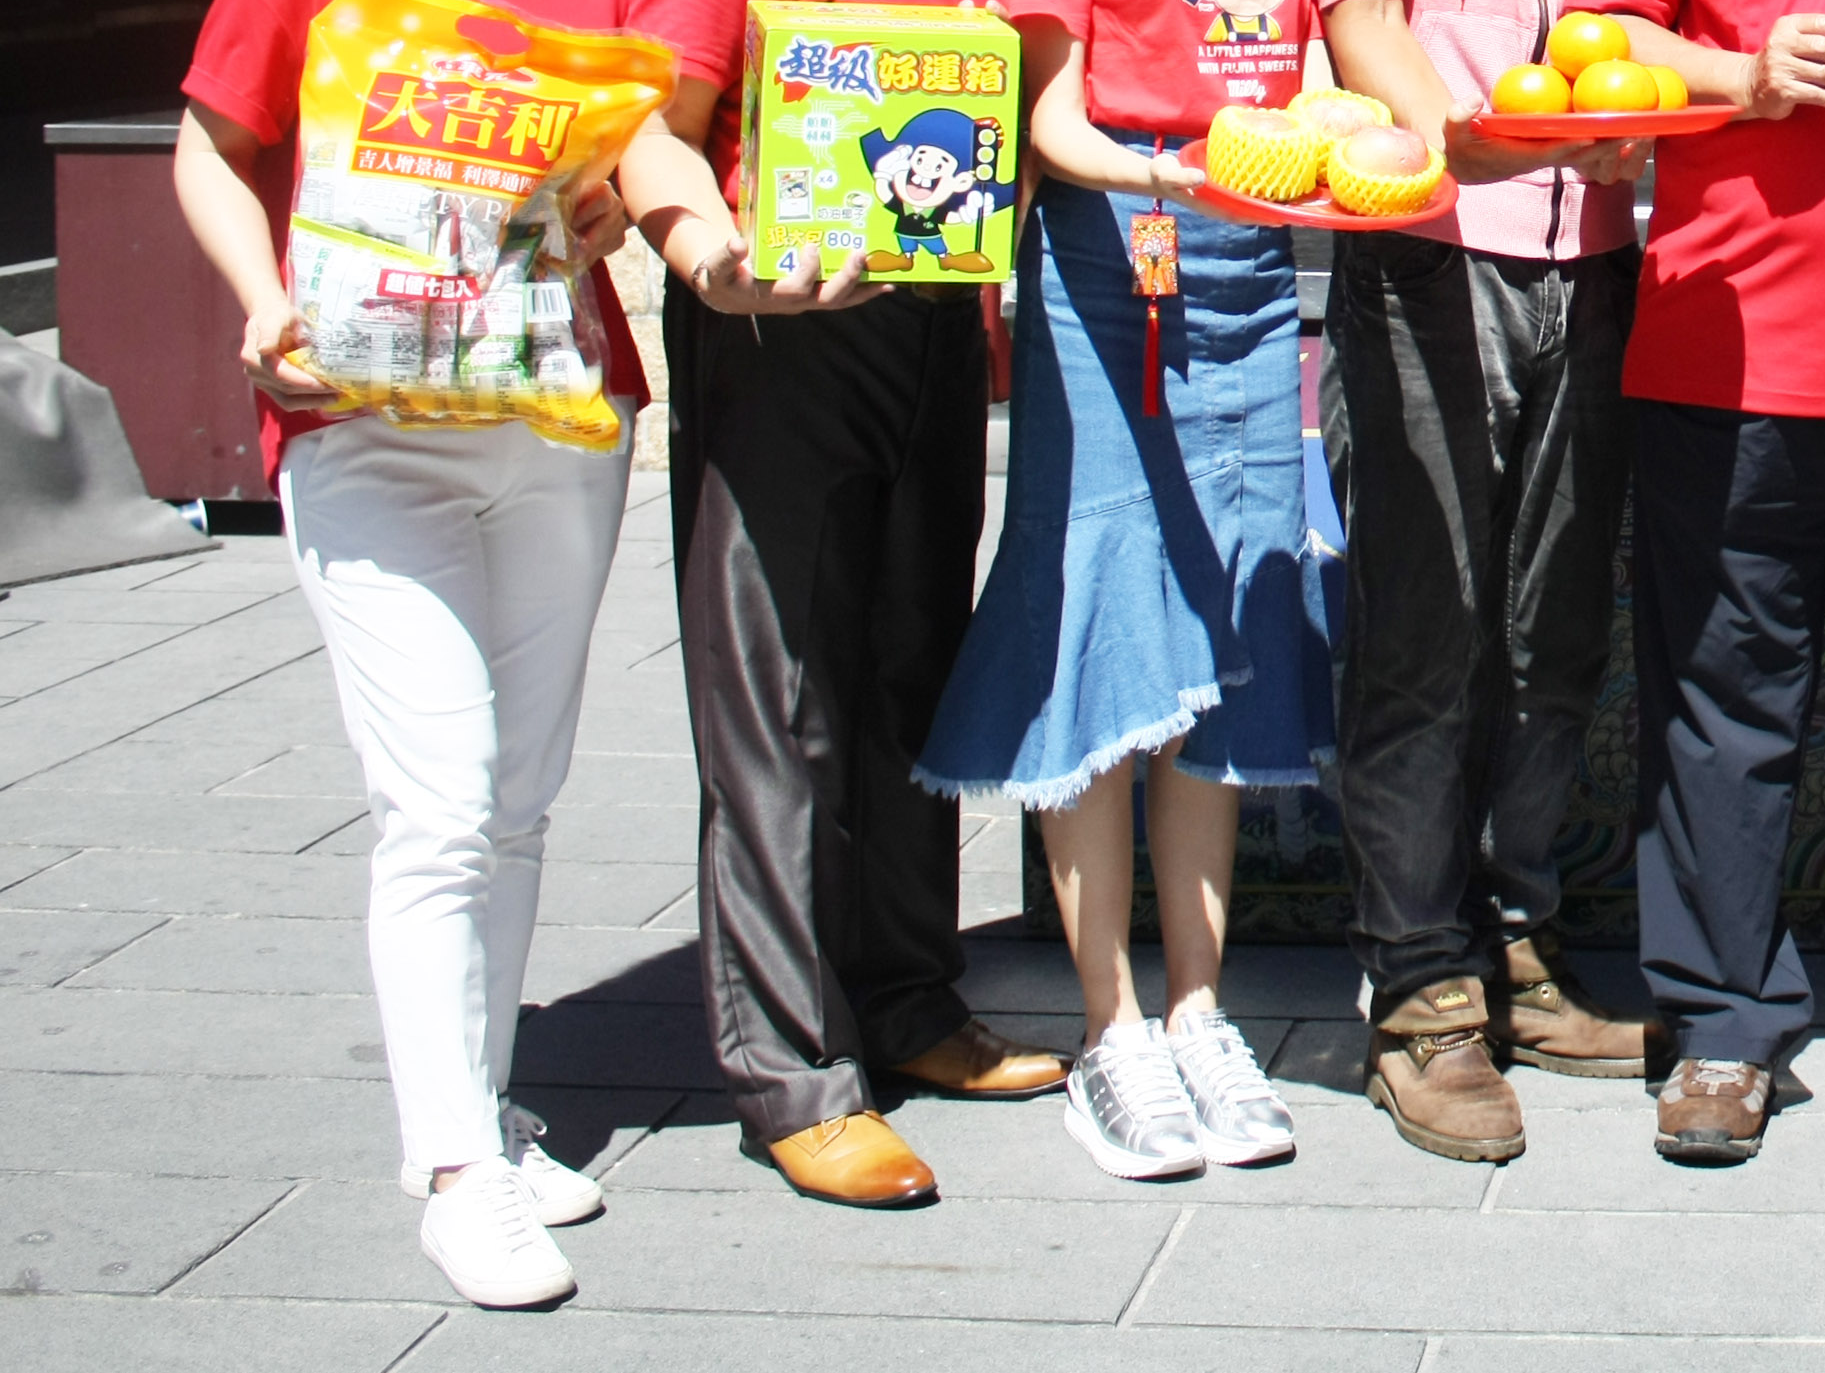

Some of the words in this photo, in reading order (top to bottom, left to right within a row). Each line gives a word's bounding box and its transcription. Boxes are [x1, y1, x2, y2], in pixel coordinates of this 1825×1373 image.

[1207, 45, 1242, 58] LITTLE
[1244, 44, 1298, 57] HAPPINESS
[367, 80, 575, 162] 大吉利
[461, 164, 537, 194] 利澤通四
[827, 232, 863, 249] 80g
